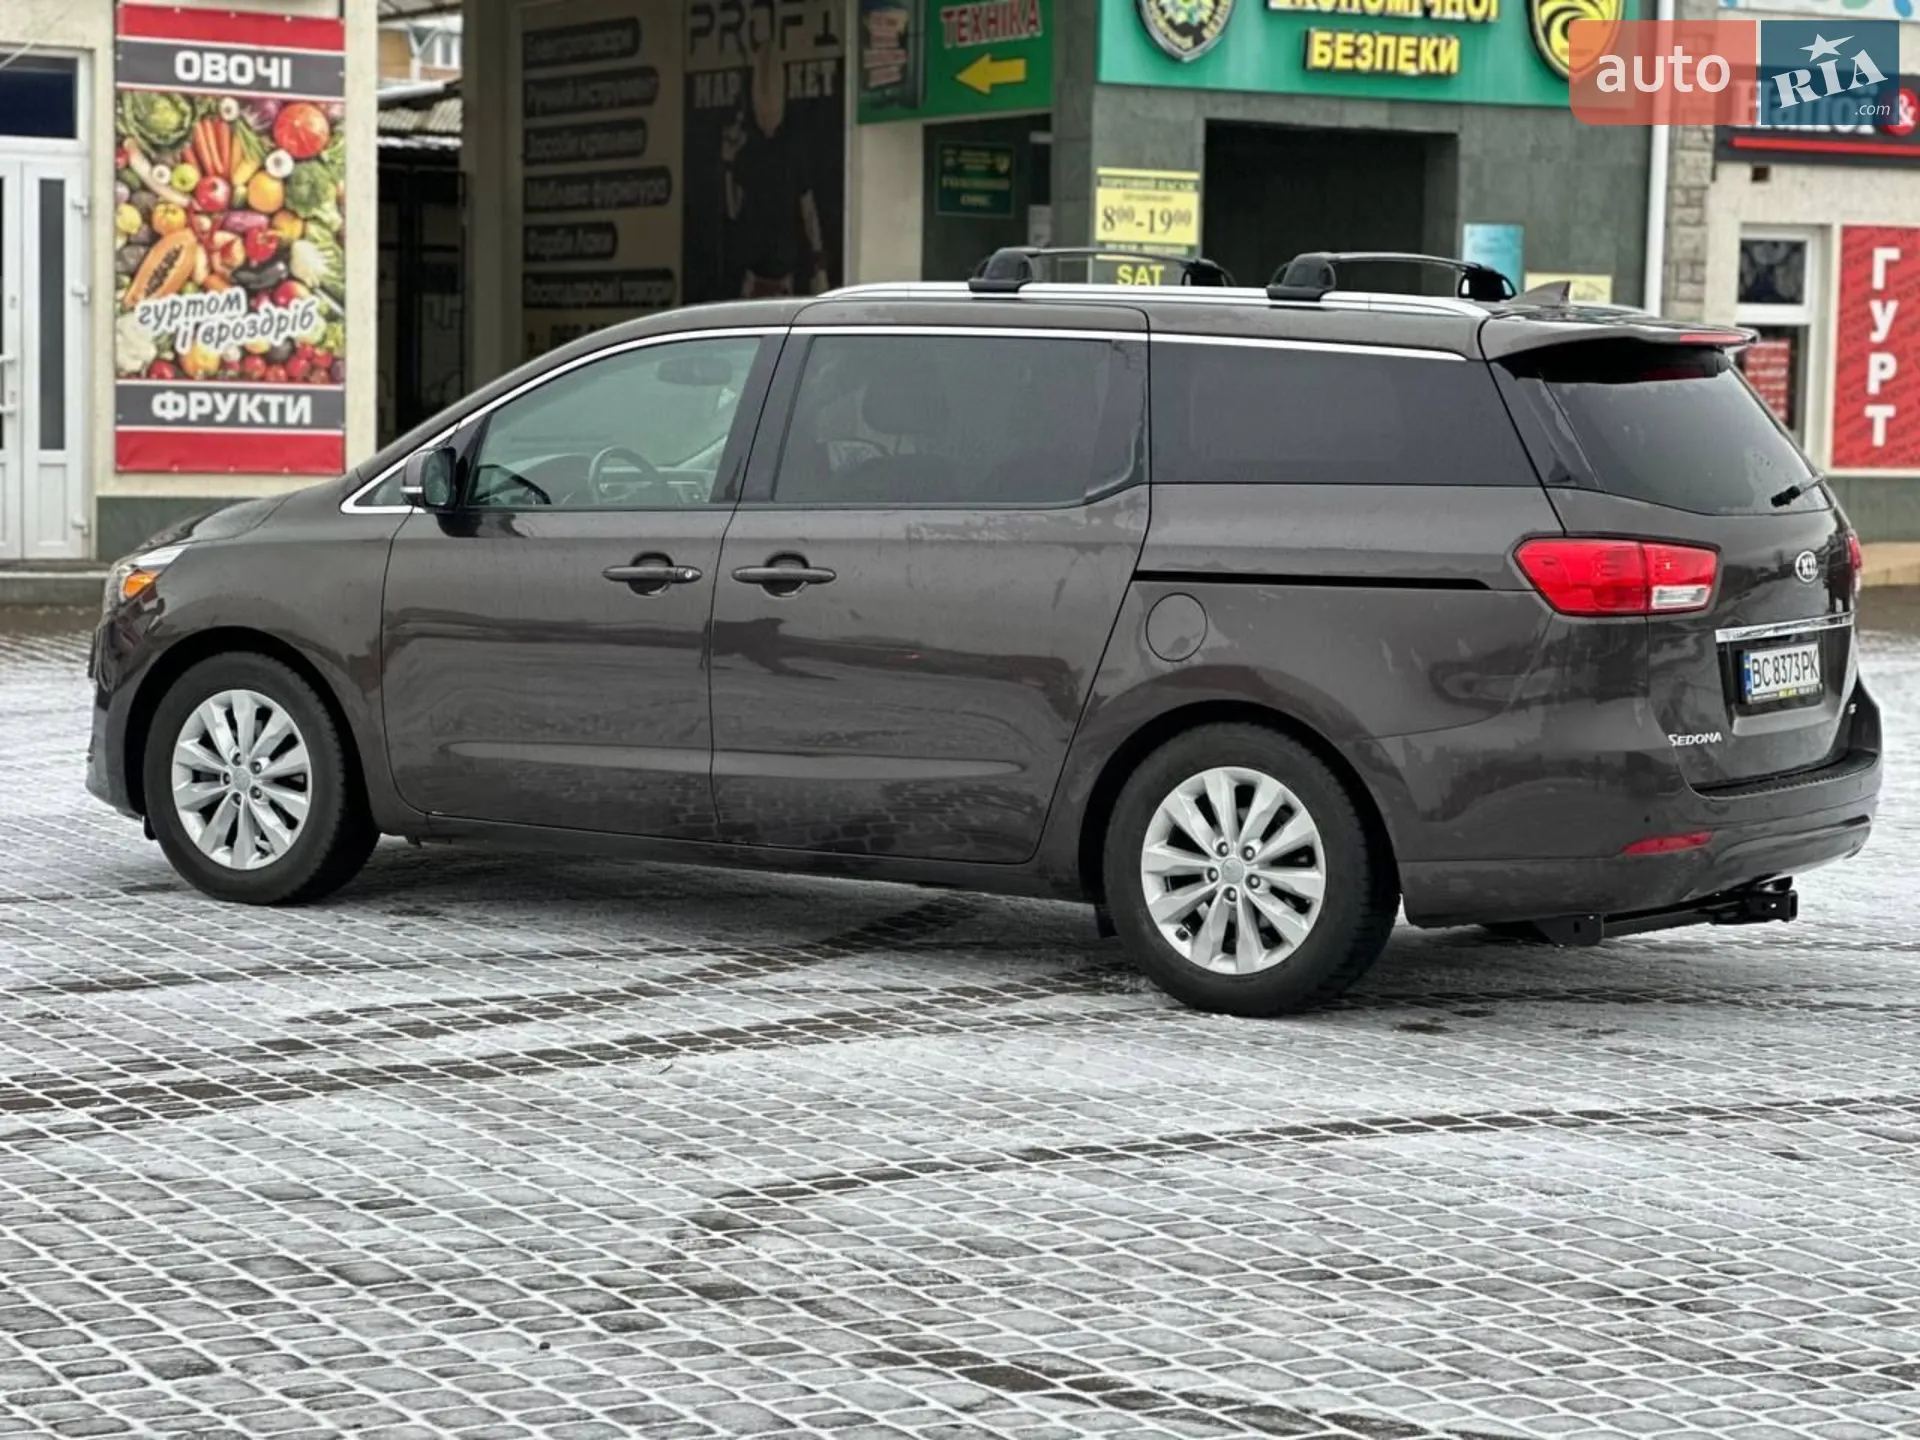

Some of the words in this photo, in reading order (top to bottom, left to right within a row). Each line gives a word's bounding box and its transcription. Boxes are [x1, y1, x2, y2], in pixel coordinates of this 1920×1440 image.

[941, 0, 1043, 48] ТЕХНІКА
[174, 51, 292, 88] ОВОЧІ
[1308, 30, 1460, 74] БЕЗПЕКИ
[1115, 263, 1166, 286] SAT
[138, 291, 243, 330] гуртом
[201, 299, 316, 349] вроздріб
[1864, 246, 1902, 447] ГУРТ
[151, 390, 313, 426] ФРУКТИ
[1667, 731, 1723, 748] SEDONA
